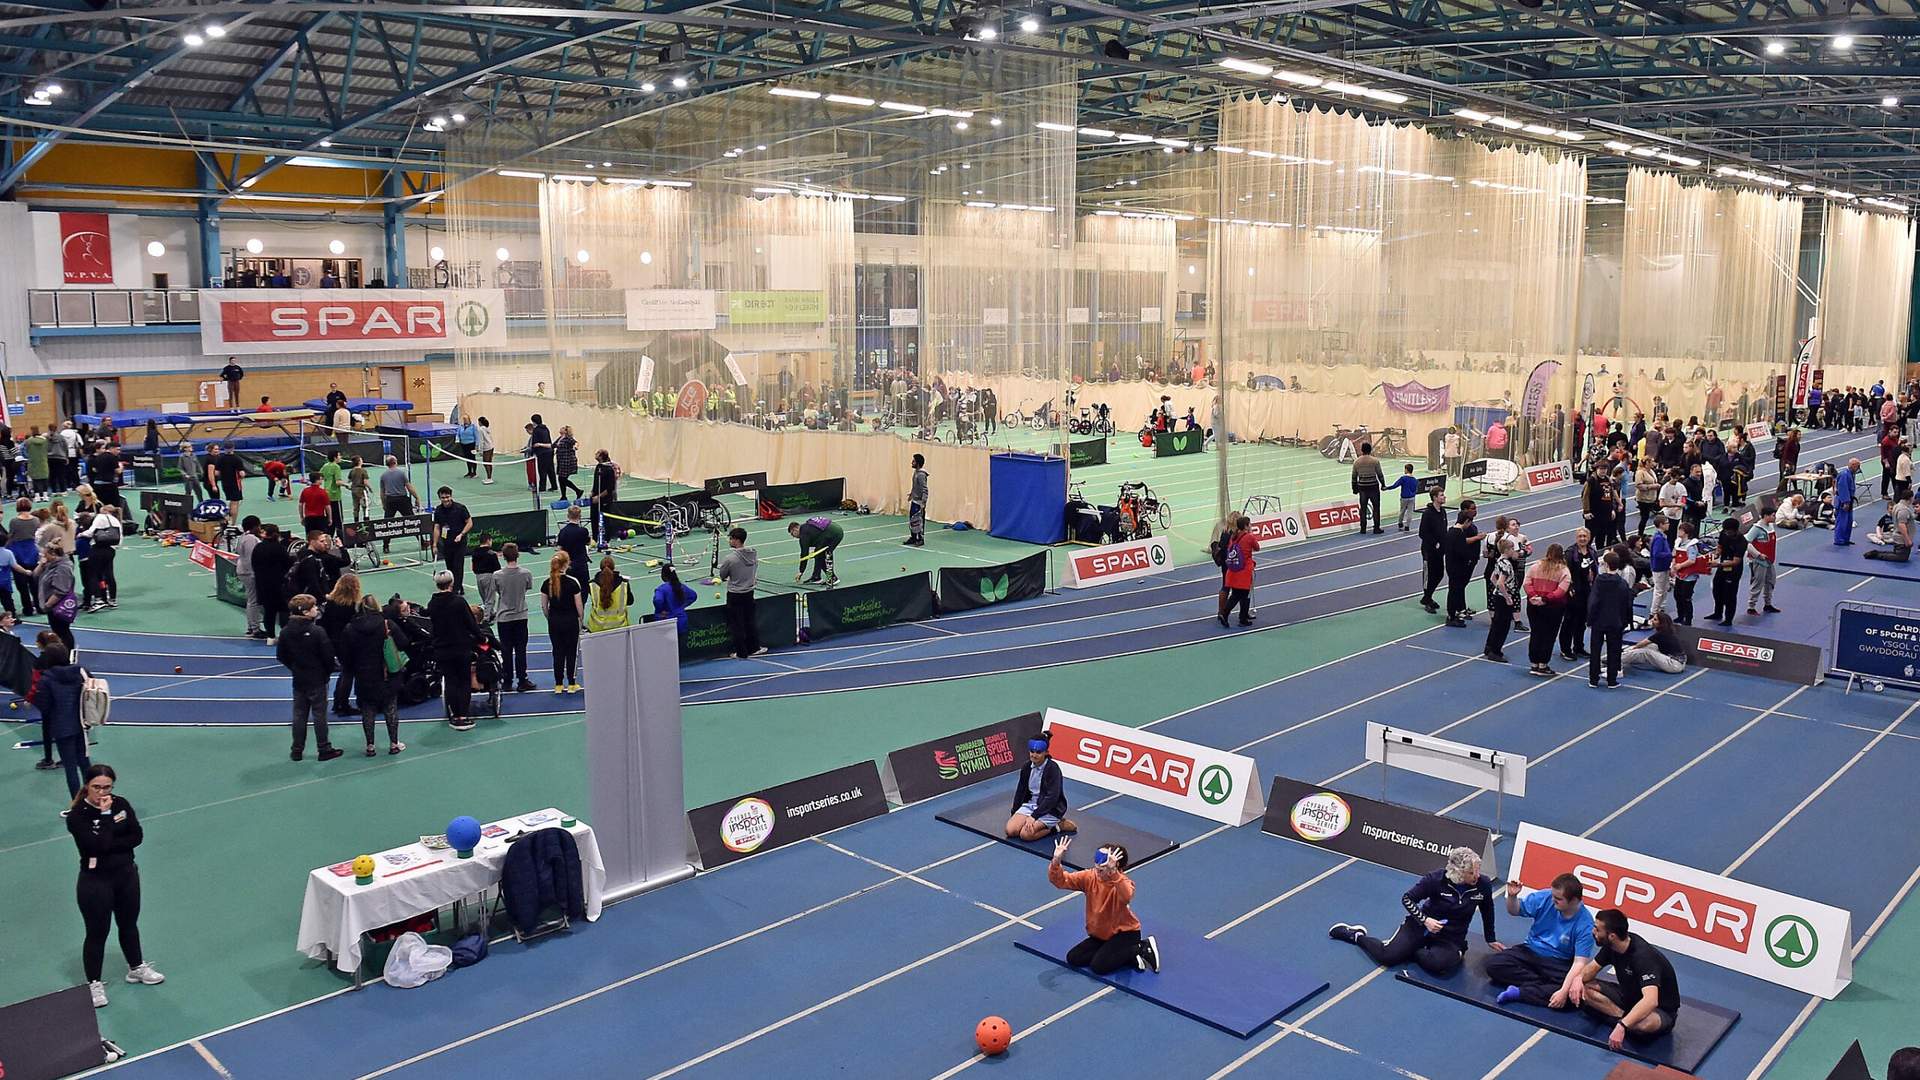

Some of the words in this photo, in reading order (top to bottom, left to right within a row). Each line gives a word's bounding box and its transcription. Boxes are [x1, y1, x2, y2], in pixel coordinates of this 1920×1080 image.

[271, 306, 443, 337] SPAR
[1797, 363, 1808, 397] SPAR
[1392, 390, 1438, 406] LIMITLESS
[1536, 469, 1563, 484] SPAR
[1319, 507, 1360, 525] SPAR
[1251, 522, 1285, 538] PAR
[1092, 550, 1149, 573] SPAR
[1865, 628, 1879, 636] OF
[1879, 630, 1909, 640] SPORT
[1893, 624, 1920, 634] CARD
[1711, 642, 1758, 657] SPAR
[1858, 644, 1917, 660] GWYDDORAU
[1881, 639, 1911, 651] YSGOL
[986, 739, 1010, 755] SPORT
[960, 755, 991, 776] CYMRU
[989, 751, 1014, 767] WALES
[1076, 737, 1190, 790] SPAR
[785, 786, 863, 819] insportseries.co.uk
[728, 813, 766, 833] insport
[1301, 804, 1339, 824] insport
[1361, 821, 1455, 857] insportseries.co.uk
[1572, 864, 1749, 943] SPAR
